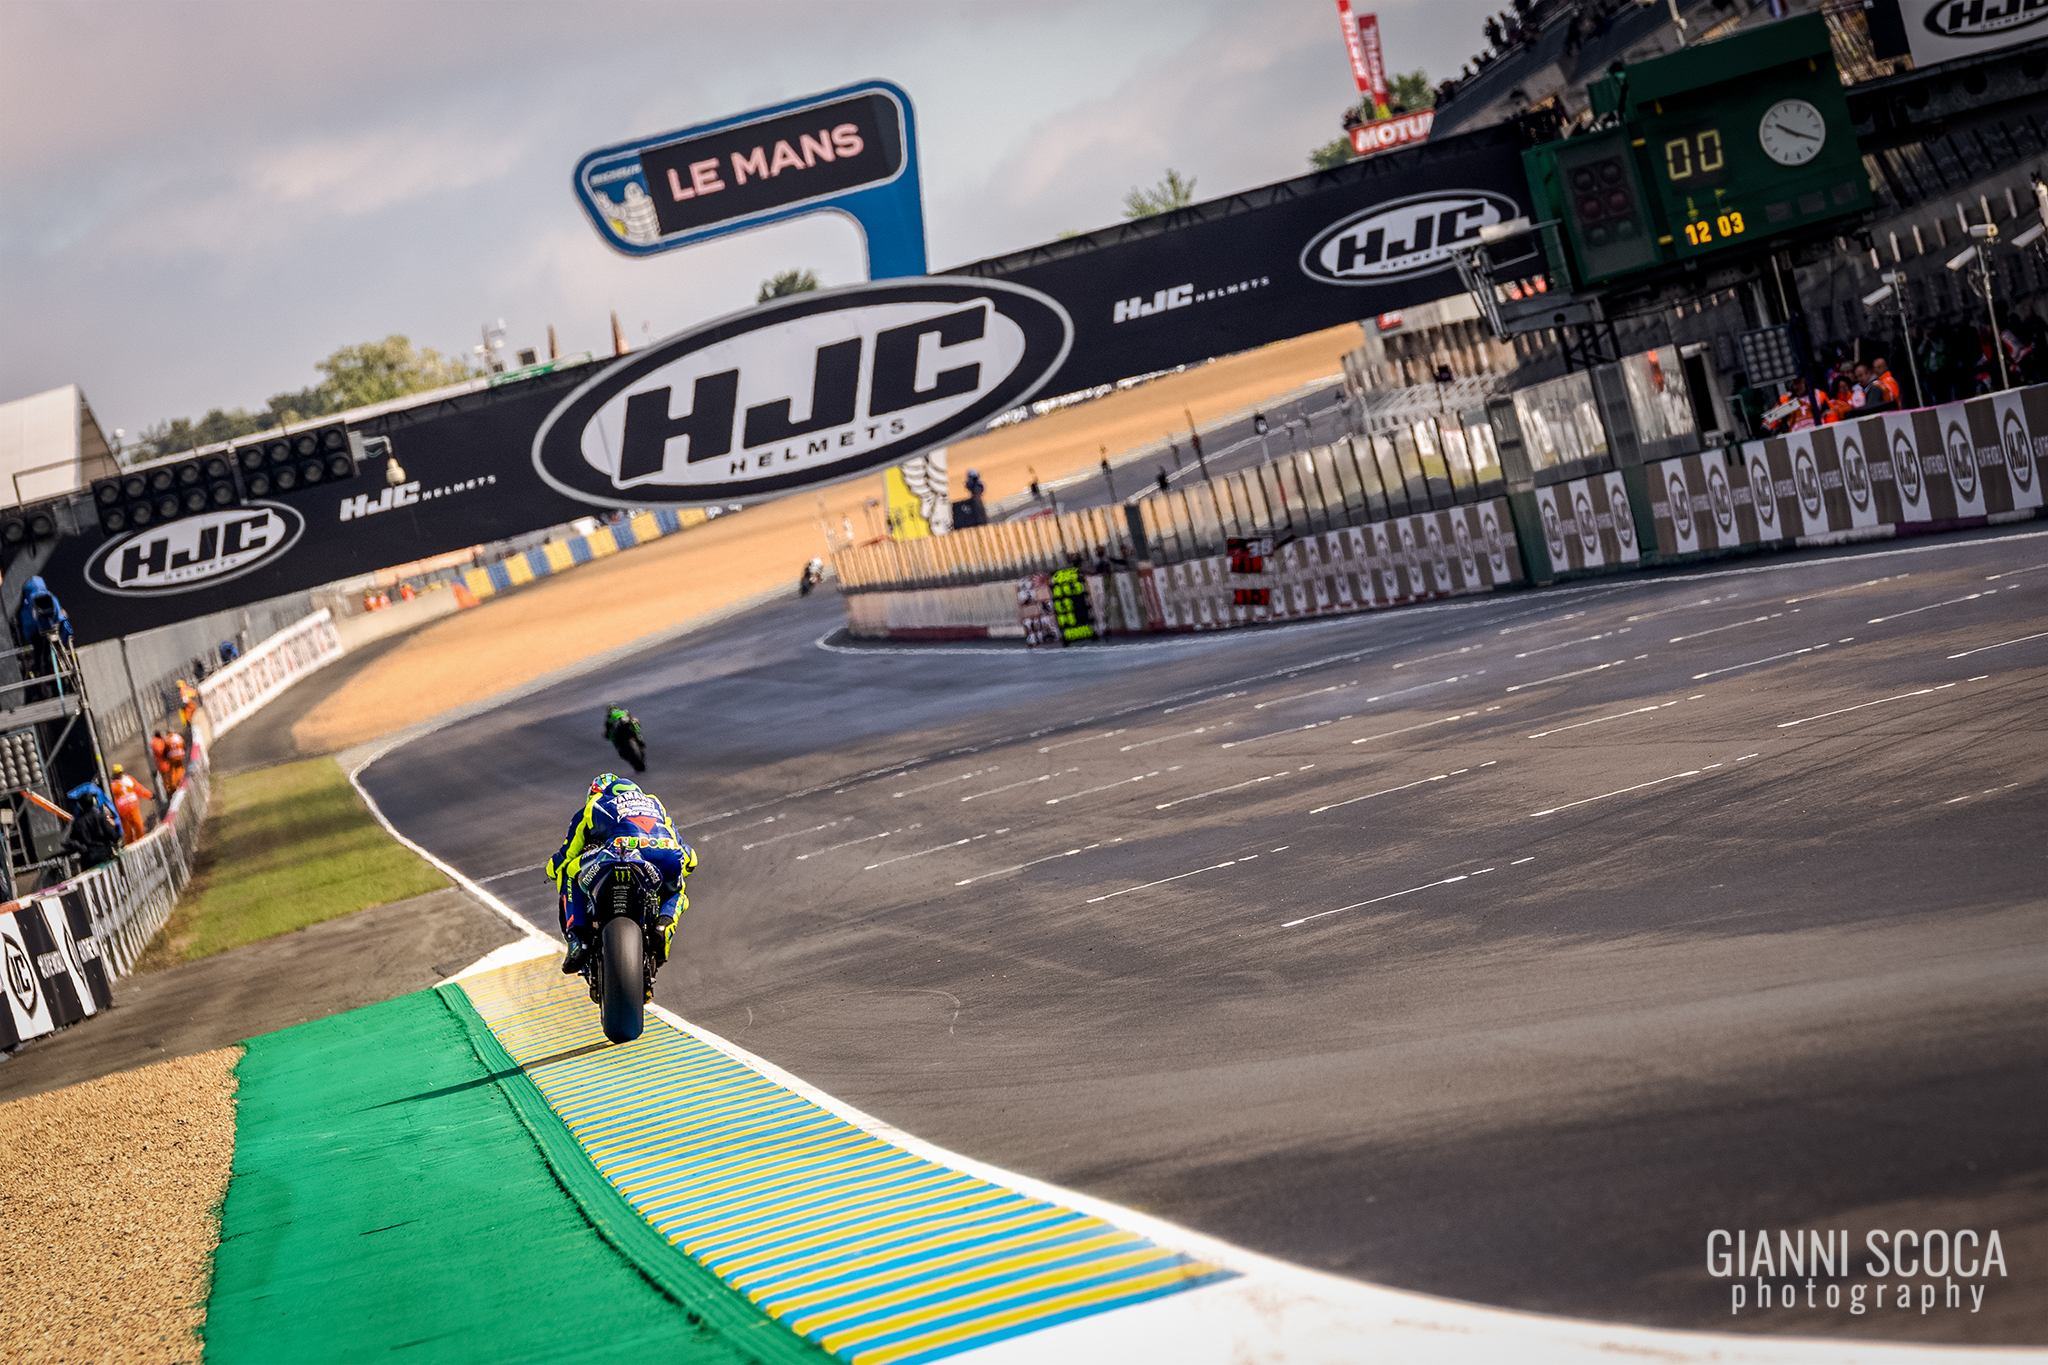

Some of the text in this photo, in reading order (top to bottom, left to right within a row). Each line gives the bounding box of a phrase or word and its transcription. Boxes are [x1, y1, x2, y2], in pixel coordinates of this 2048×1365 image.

[667, 157, 726, 202] LE
[730, 123, 865, 185] MANS
[1665, 129, 1724, 180] 00
[1337, 202, 1486, 273] HJC
[1685, 211, 1745, 245] 12 03
[1113, 276, 1270, 324] HJC HELMETS
[619, 304, 987, 482] HJC
[730, 418, 906, 475] HELMETS
[340, 474, 497, 522] HJC HELMETS
[120, 512, 270, 583] HJC
